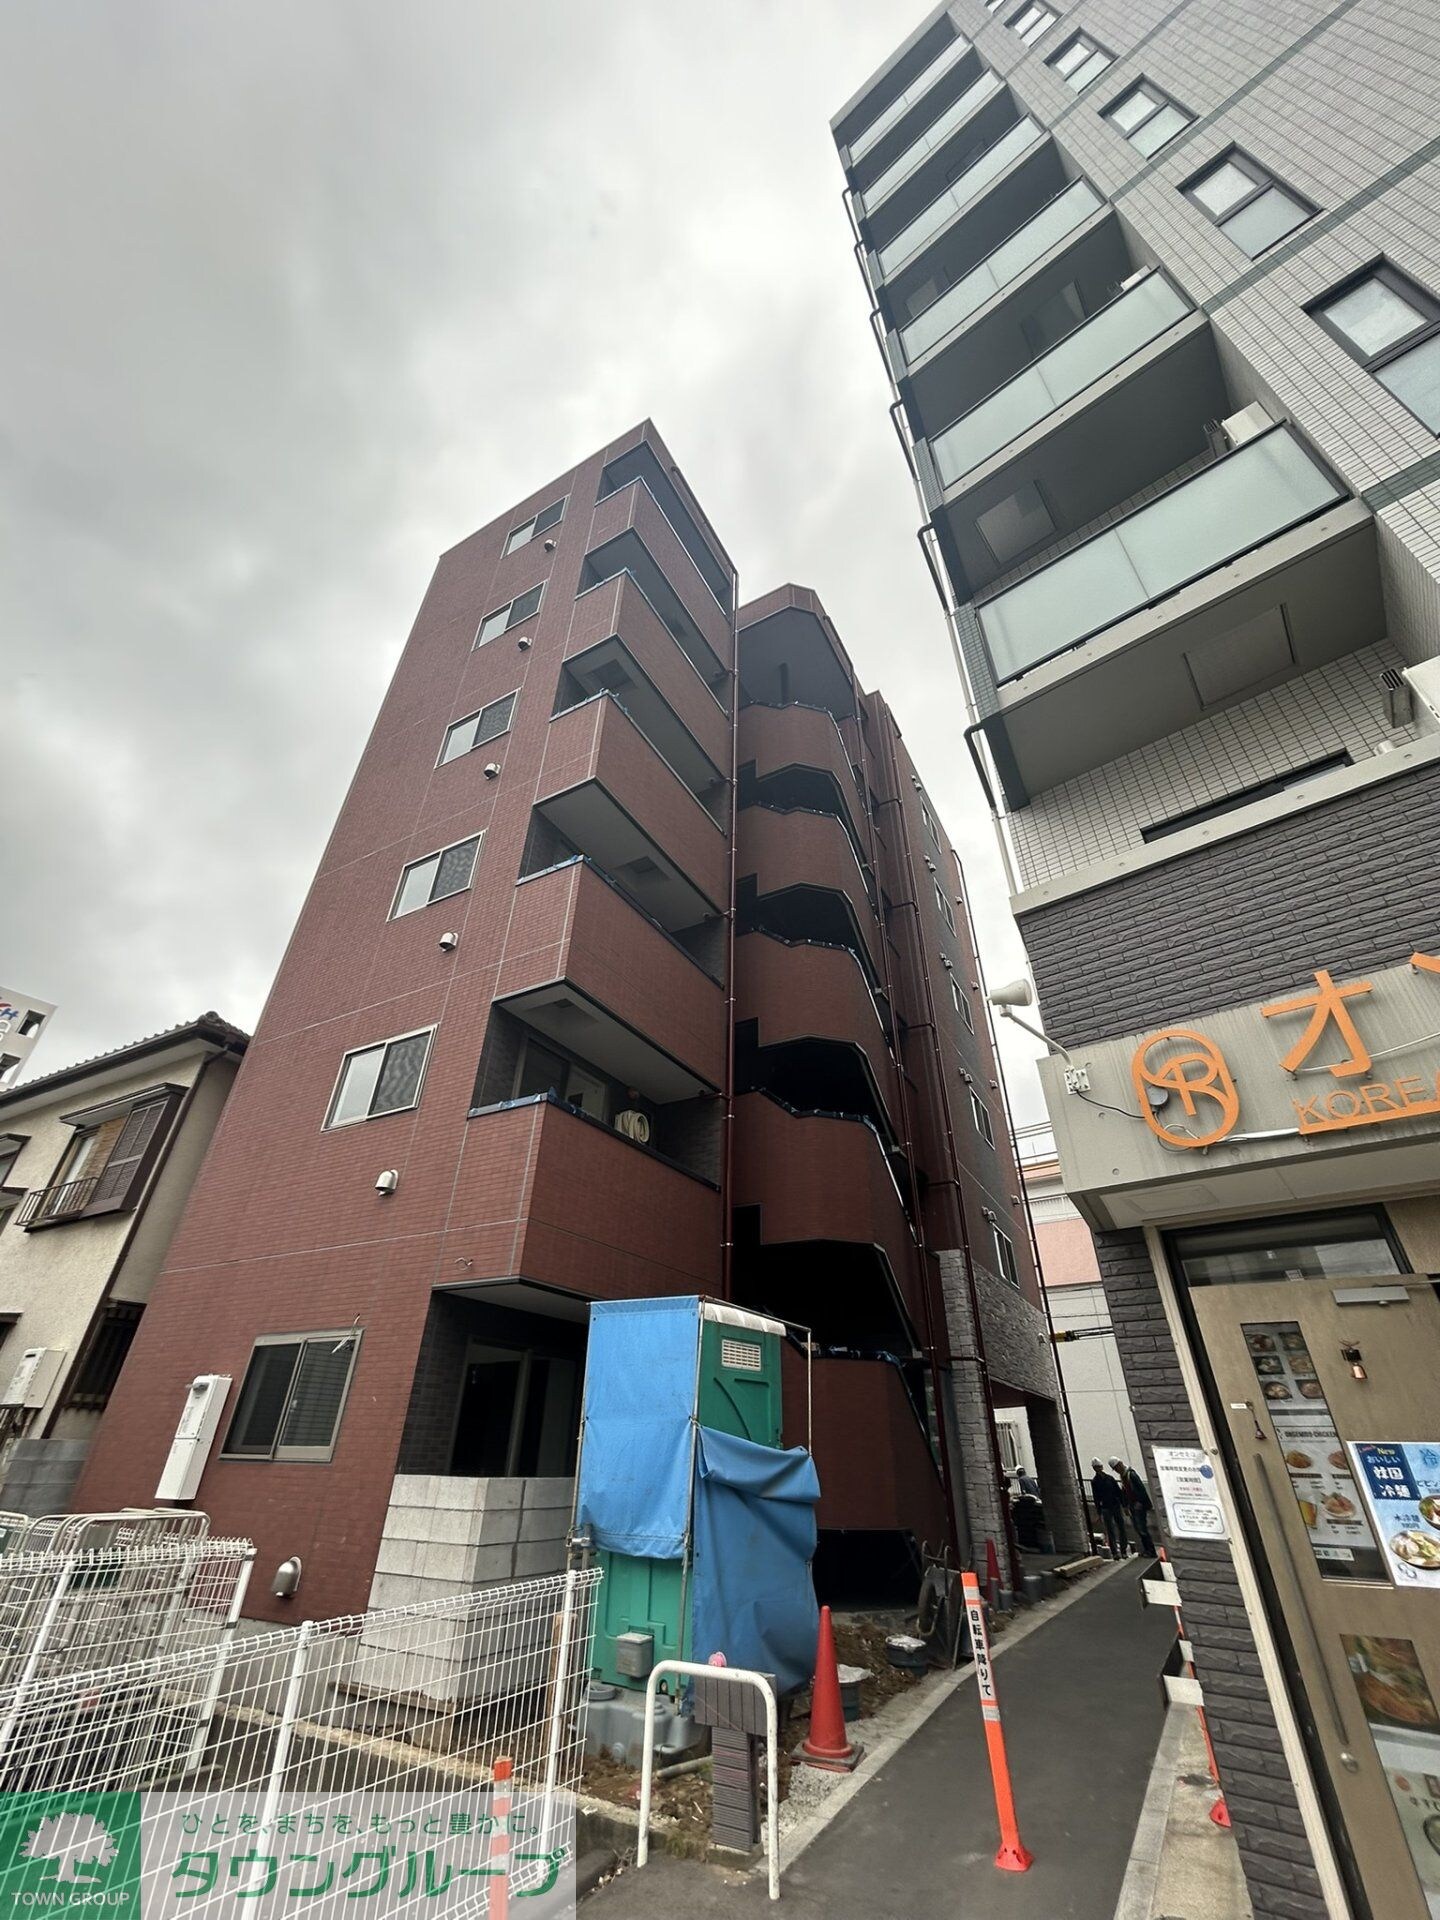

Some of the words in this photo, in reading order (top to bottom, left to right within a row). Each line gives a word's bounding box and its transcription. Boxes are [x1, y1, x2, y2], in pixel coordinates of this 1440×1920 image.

[1366, 1455, 1401, 1464] おいしい
[1373, 1465, 1404, 1480] 韓国
[1379, 1484, 1411, 1498] 冷麺
[970, 1610, 991, 1696] 自転車降りて
